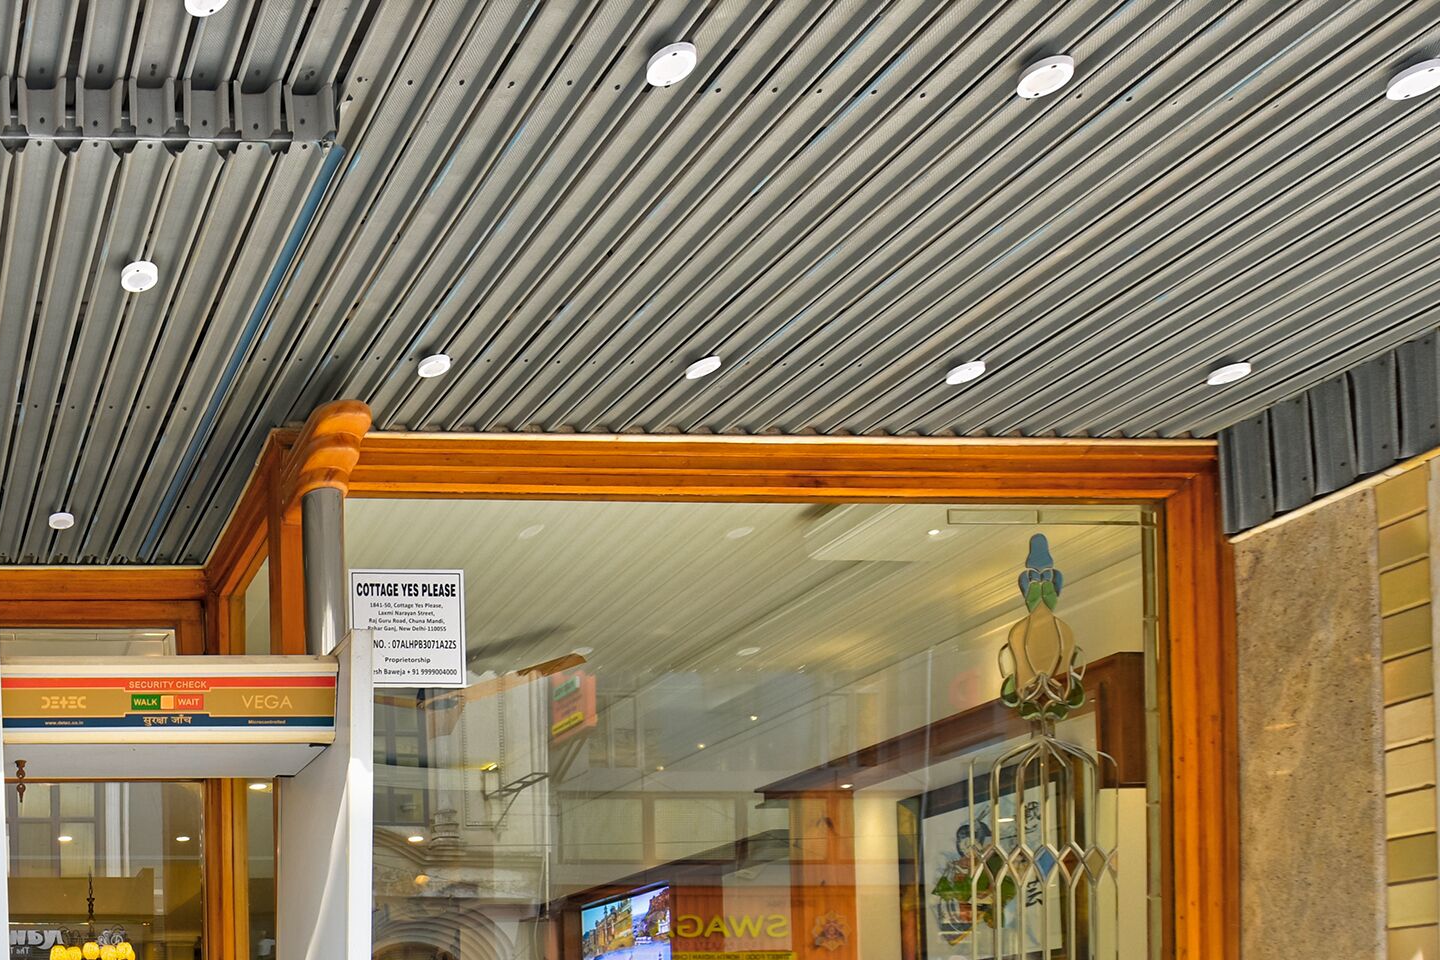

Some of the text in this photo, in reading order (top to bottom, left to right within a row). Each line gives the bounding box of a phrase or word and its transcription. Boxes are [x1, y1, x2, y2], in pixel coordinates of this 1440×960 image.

[356, 582, 456, 597] COTTAGE YES PLEASE
[373, 639, 386, 649] NO.
[384, 656, 431, 664] Proprietorship
[383, 668, 406, 676] Baweja
[128, 680, 207, 689] SECURITY CHECK
[40, 695, 87, 709] DETEC
[133, 698, 200, 706] WALK WAIT
[241, 694, 293, 709] VEGA
[143, 716, 168, 726] सुरक्षा
